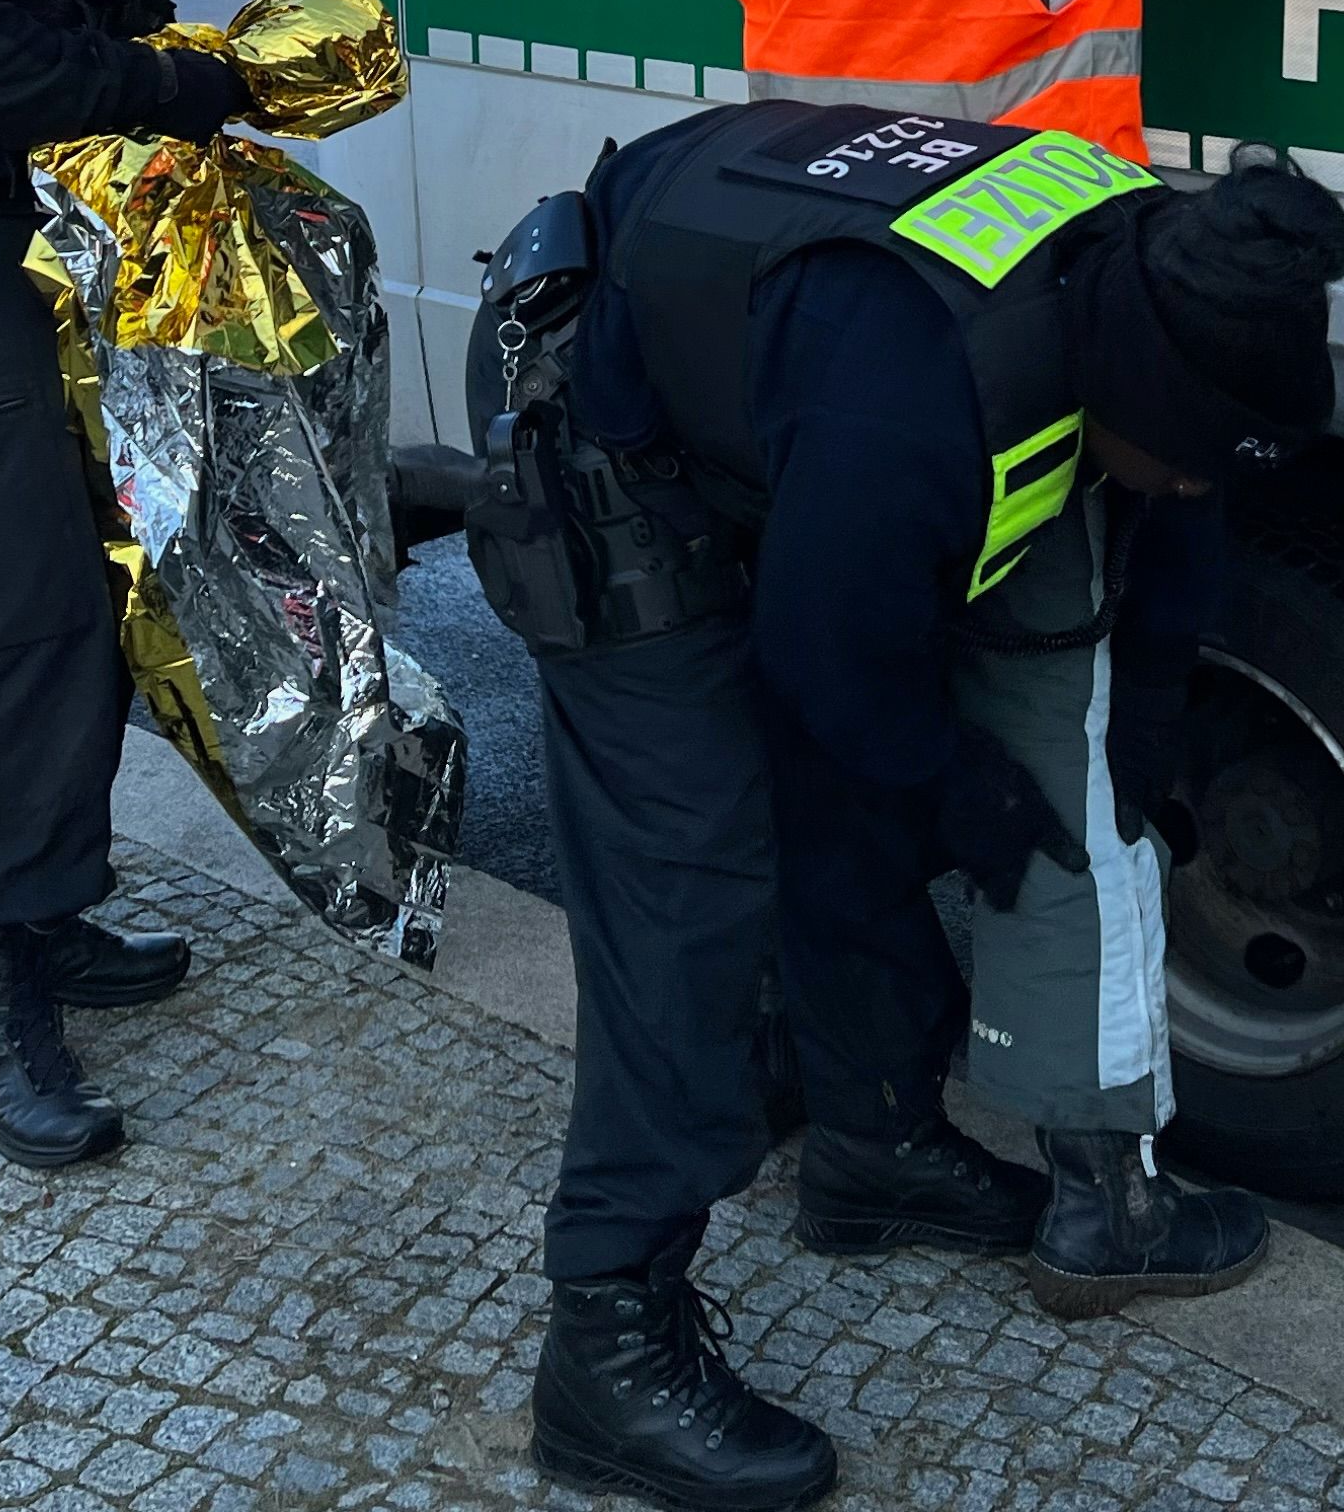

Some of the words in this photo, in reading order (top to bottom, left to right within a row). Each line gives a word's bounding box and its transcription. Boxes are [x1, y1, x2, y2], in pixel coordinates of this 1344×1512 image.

[807, 115, 945, 180] 12216
[888, 138, 979, 174] BE
[911, 143, 1146, 272] POLIZEI
